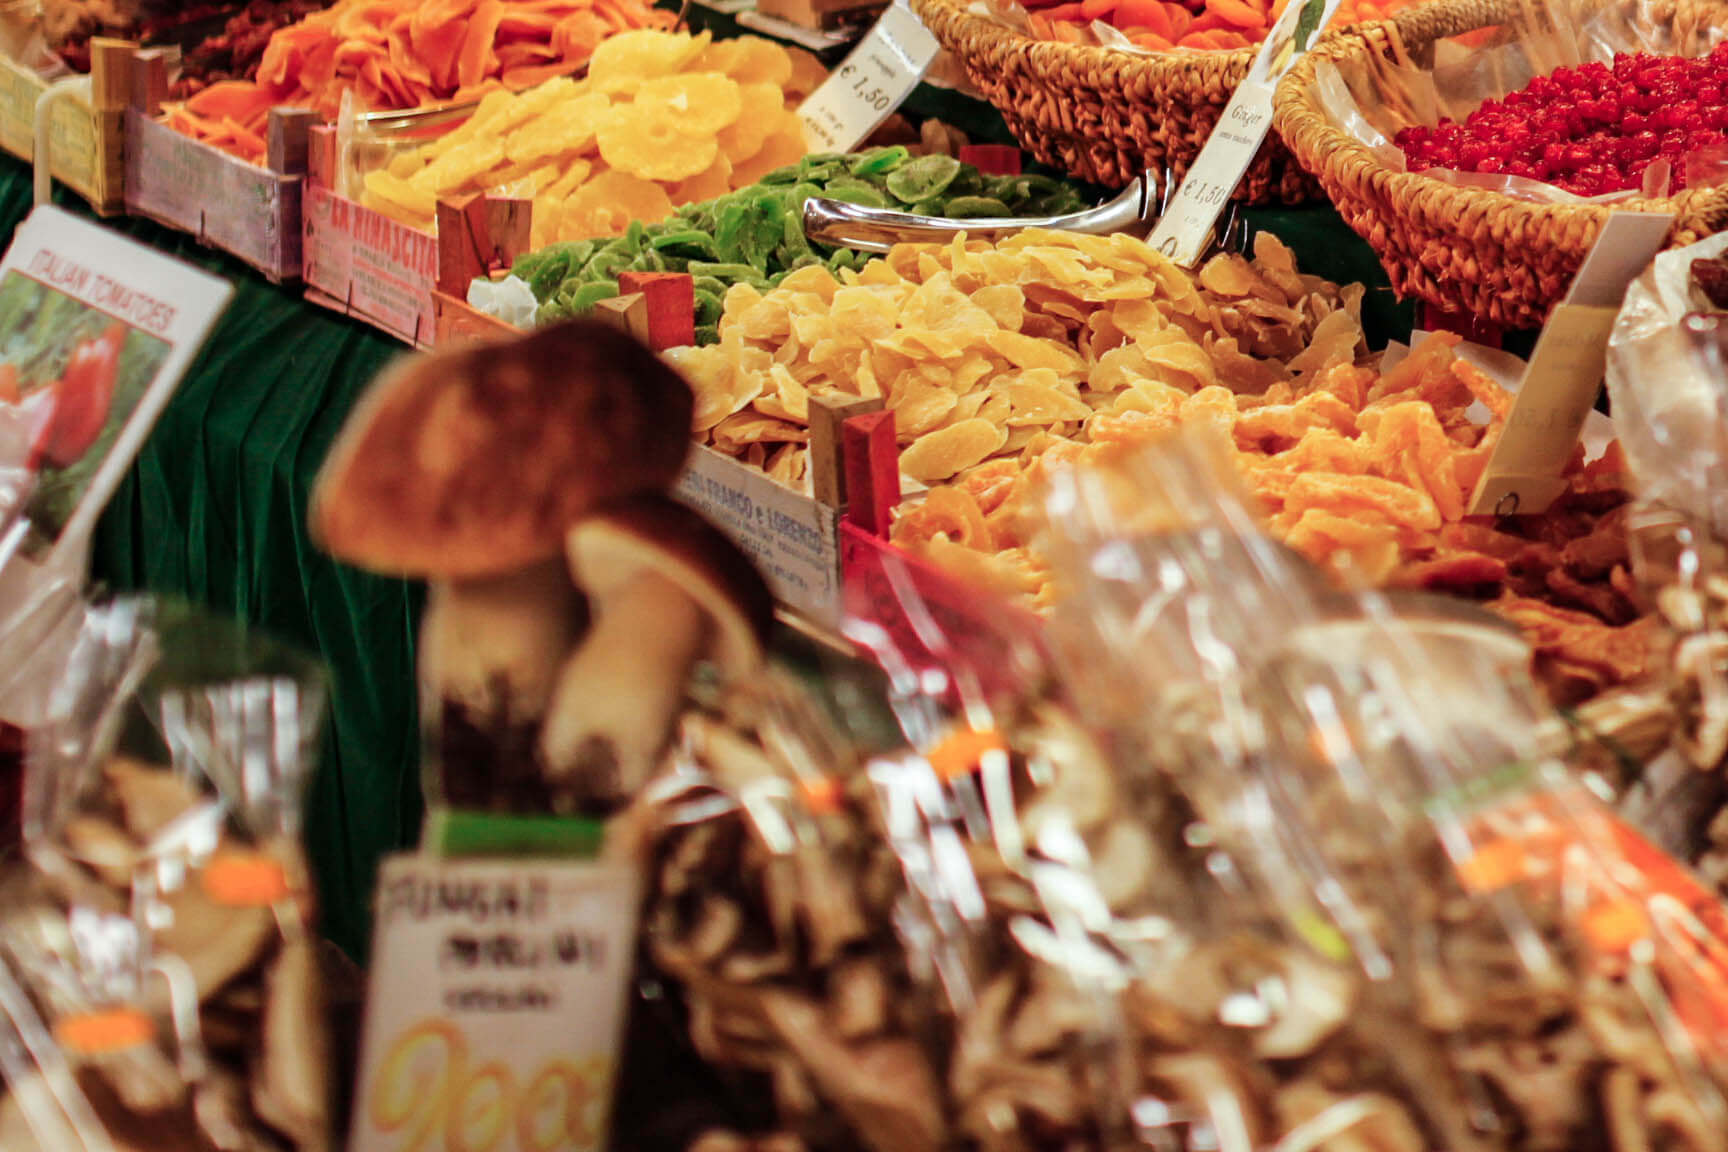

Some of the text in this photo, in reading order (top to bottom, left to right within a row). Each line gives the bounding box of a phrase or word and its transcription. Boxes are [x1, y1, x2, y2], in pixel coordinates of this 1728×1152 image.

[840, 64, 891, 112] € 1,50
[1231, 104, 1262, 128] Ginger
[1183, 178, 1226, 205] € 1,50
[28, 249, 177, 332] ITALIAN TOMATOES
[706, 478, 753, 519] FRANCO
[767, 507, 824, 554] LORENZO
